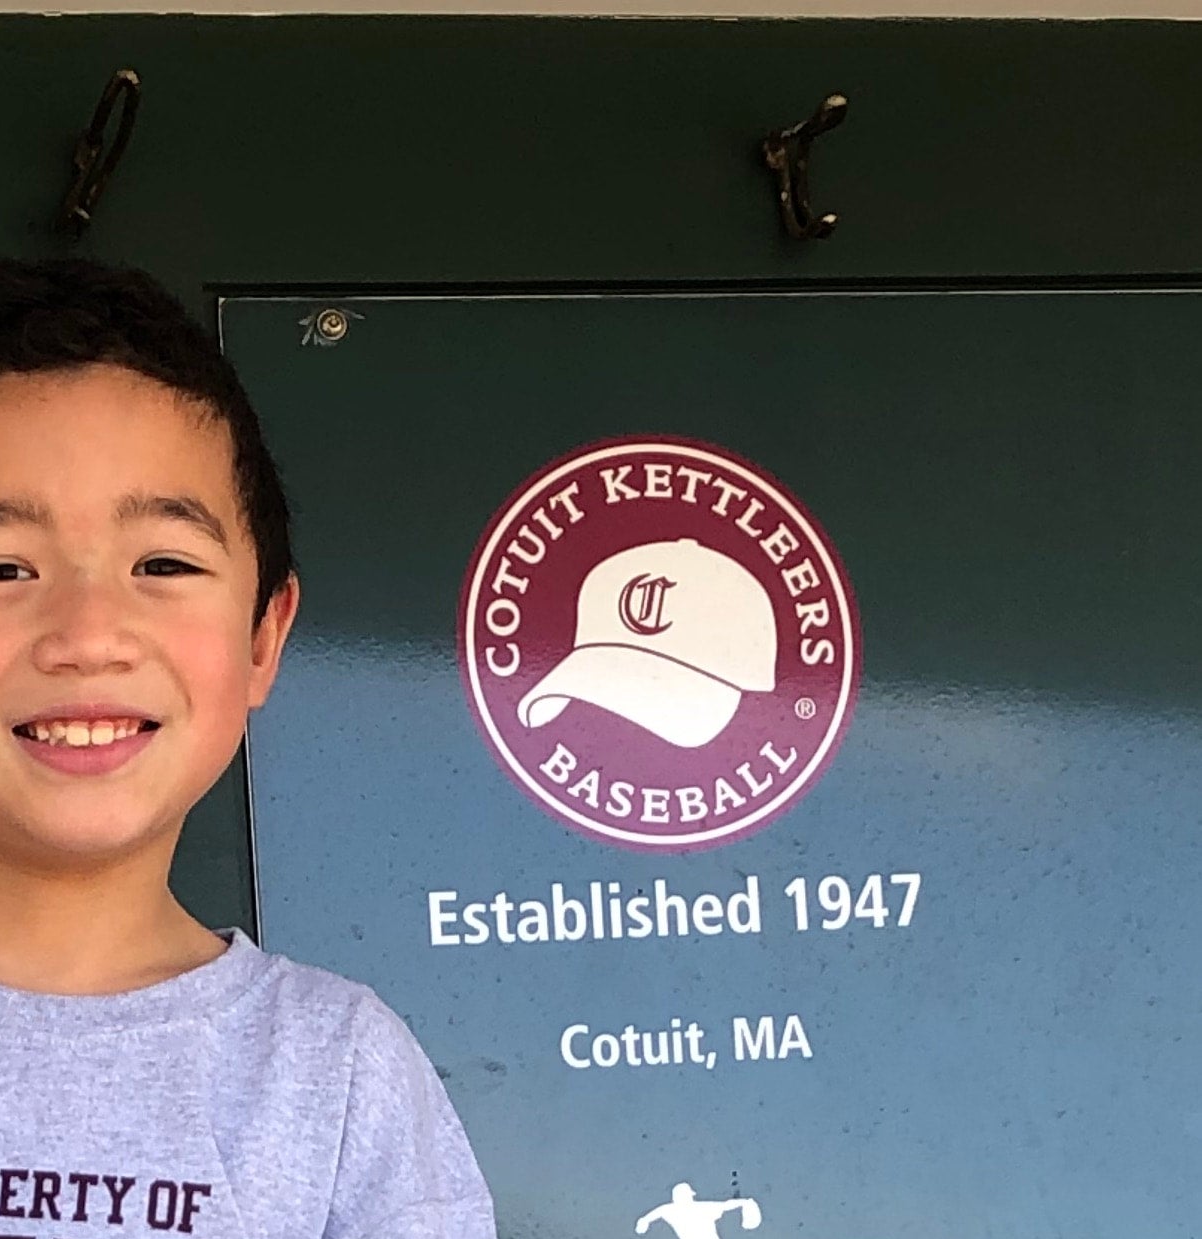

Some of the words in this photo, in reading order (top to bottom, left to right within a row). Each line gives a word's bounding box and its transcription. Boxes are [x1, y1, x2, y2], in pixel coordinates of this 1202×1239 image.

[485, 481, 585, 677] COTUIT
[599, 464, 835, 667] KETTLEERS
[539, 741, 798, 824] BASEBALL
[428, 875, 762, 946] Established
[784, 872, 922, 932] 1947
[560, 1017, 717, 1070] Cotuit,
[732, 1014, 813, 1061] MA
[146, 1179, 212, 1234] OF
